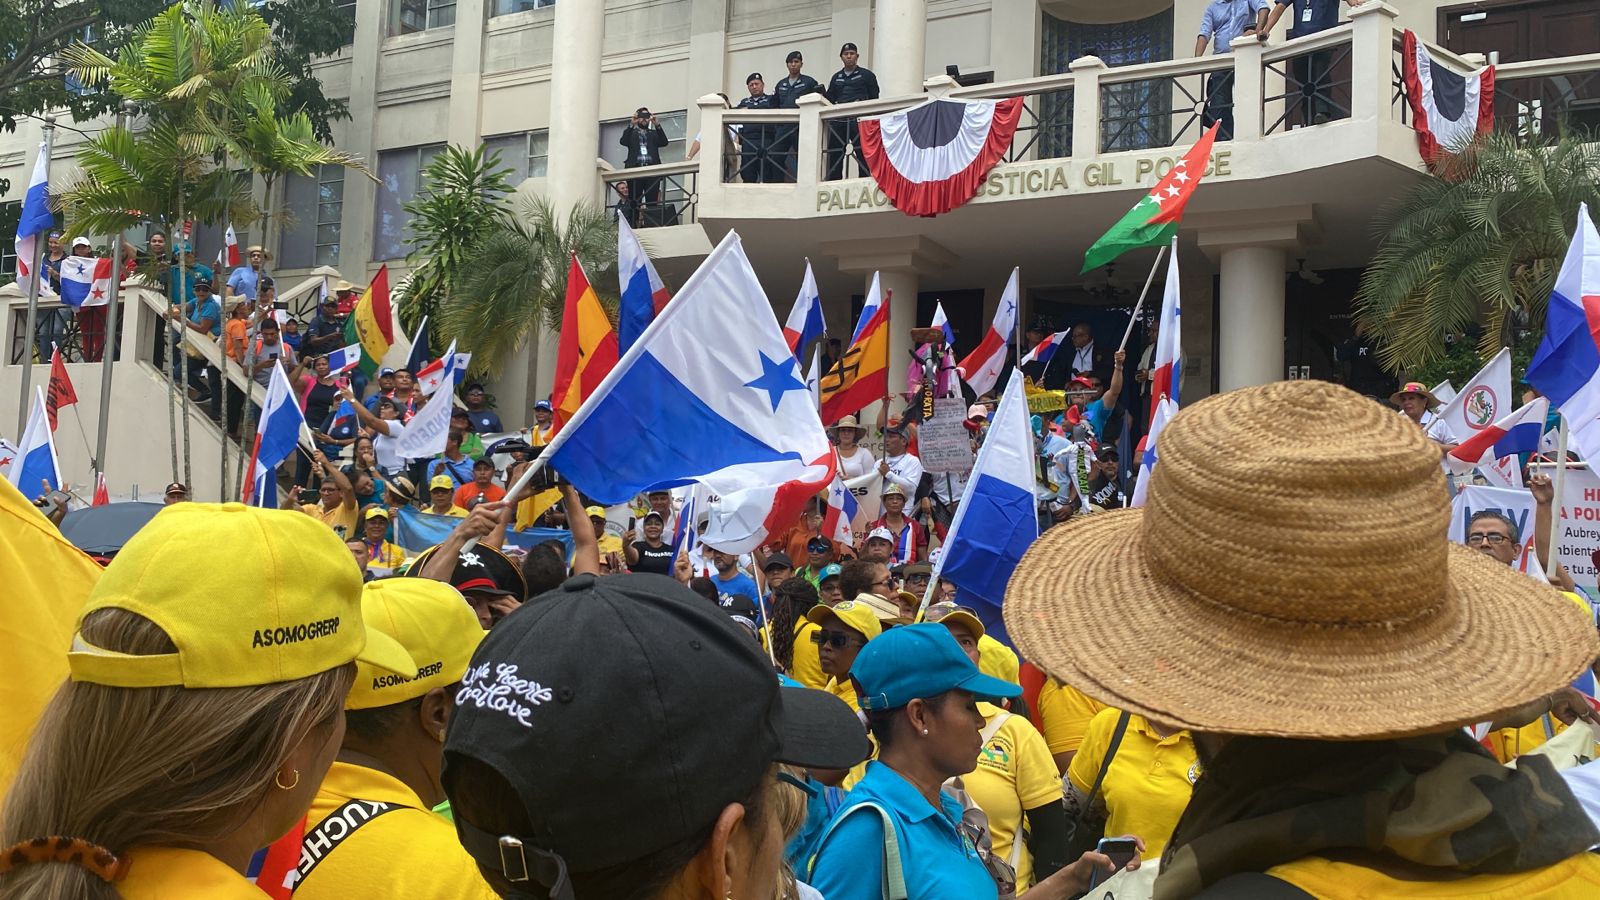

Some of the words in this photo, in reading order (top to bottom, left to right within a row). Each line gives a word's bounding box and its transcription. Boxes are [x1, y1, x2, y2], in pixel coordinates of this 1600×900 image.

[816, 186, 893, 211] PALAC
[1083, 162, 1122, 187] GIL
[1135, 151, 1231, 183] POCE
[1558, 545, 1600, 557] bient
[1572, 564, 1584, 575] tu
[252, 616, 340, 648] ASOMOGRERP
[372, 661, 443, 690] ASOMRERP
